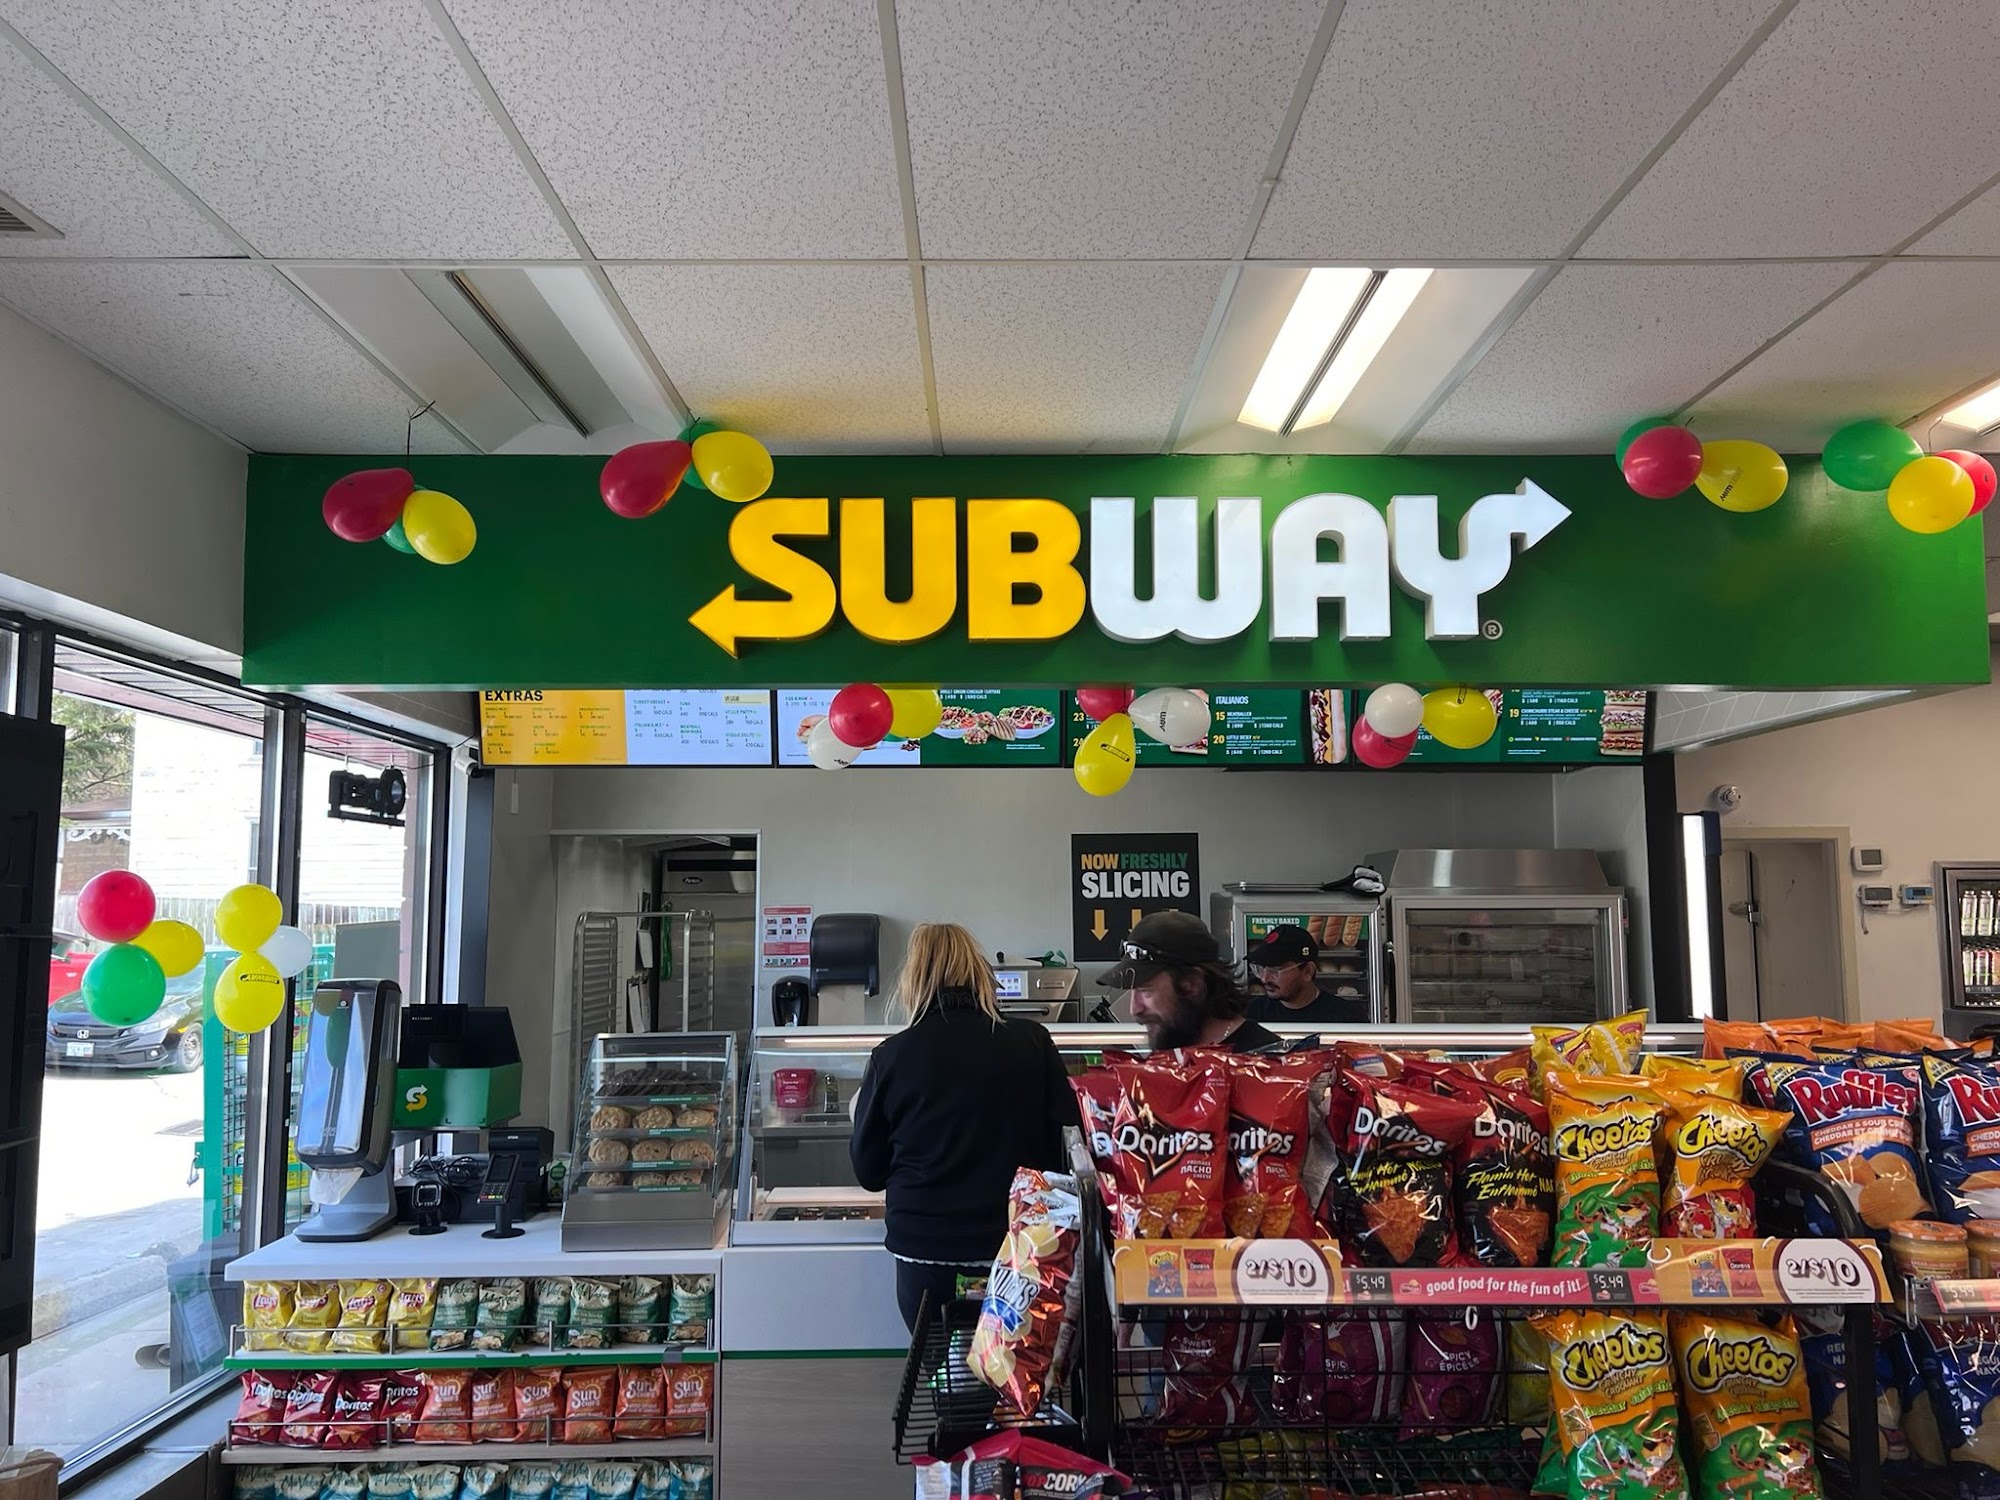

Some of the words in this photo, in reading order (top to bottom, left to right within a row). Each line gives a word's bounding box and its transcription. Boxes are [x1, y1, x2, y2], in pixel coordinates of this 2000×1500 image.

[688, 477, 1573, 657] SUBWAY
[485, 690, 543, 701] EXTRAS
[1215, 696, 1249, 705] ITALIANOS
[1073, 713, 1084, 722] 23
[1216, 712, 1226, 721] 15
[1509, 708, 1520, 718] 19
[1213, 735, 1225, 744] 20
[1081, 853, 1119, 870] NOW
[1120, 852, 1188, 869] FRESHLY
[1082, 870, 1190, 899] SLICING
[1119, 1125, 1213, 1156] Doritos
[1230, 1126, 1294, 1154] oritos
[1354, 1106, 1448, 1156] Doritos
[1475, 1118, 1549, 1156] Doritos
[1556, 1114, 1657, 1163] Cheetos
[1678, 1114, 1768, 1165] Cheetos
[1516, 1168, 1537, 1182] Hot
[1189, 1260, 1210, 1271] Doritos
[1245, 1258, 1317, 1288] 2/$10
[1730, 1260, 1750, 1271] Doritos
[1786, 1258, 1860, 1288] 2/$10
[1356, 1274, 1386, 1290] $5.49
[1426, 1279, 1455, 1297] good
[1458, 1276, 1484, 1291] food
[1487, 1278, 1506, 1293] for
[1508, 1279, 1528, 1294] the
[1530, 1282, 1550, 1297] fun
[1552, 1280, 1566, 1297] of
[1566, 1278, 1580, 1292] it!
[1593, 1274, 1624, 1289] $5.49
[1444, 1351, 1471, 1361] SPICY
[1560, 1322, 1668, 1391] Cheetos
[1684, 1334, 1798, 1394] Cheetos
[626, 1380, 653, 1399] Sun
[674, 1380, 700, 1400] Sun
[335, 1398, 374, 1411] Doritos
[571, 1390, 598, 1409] Sun
